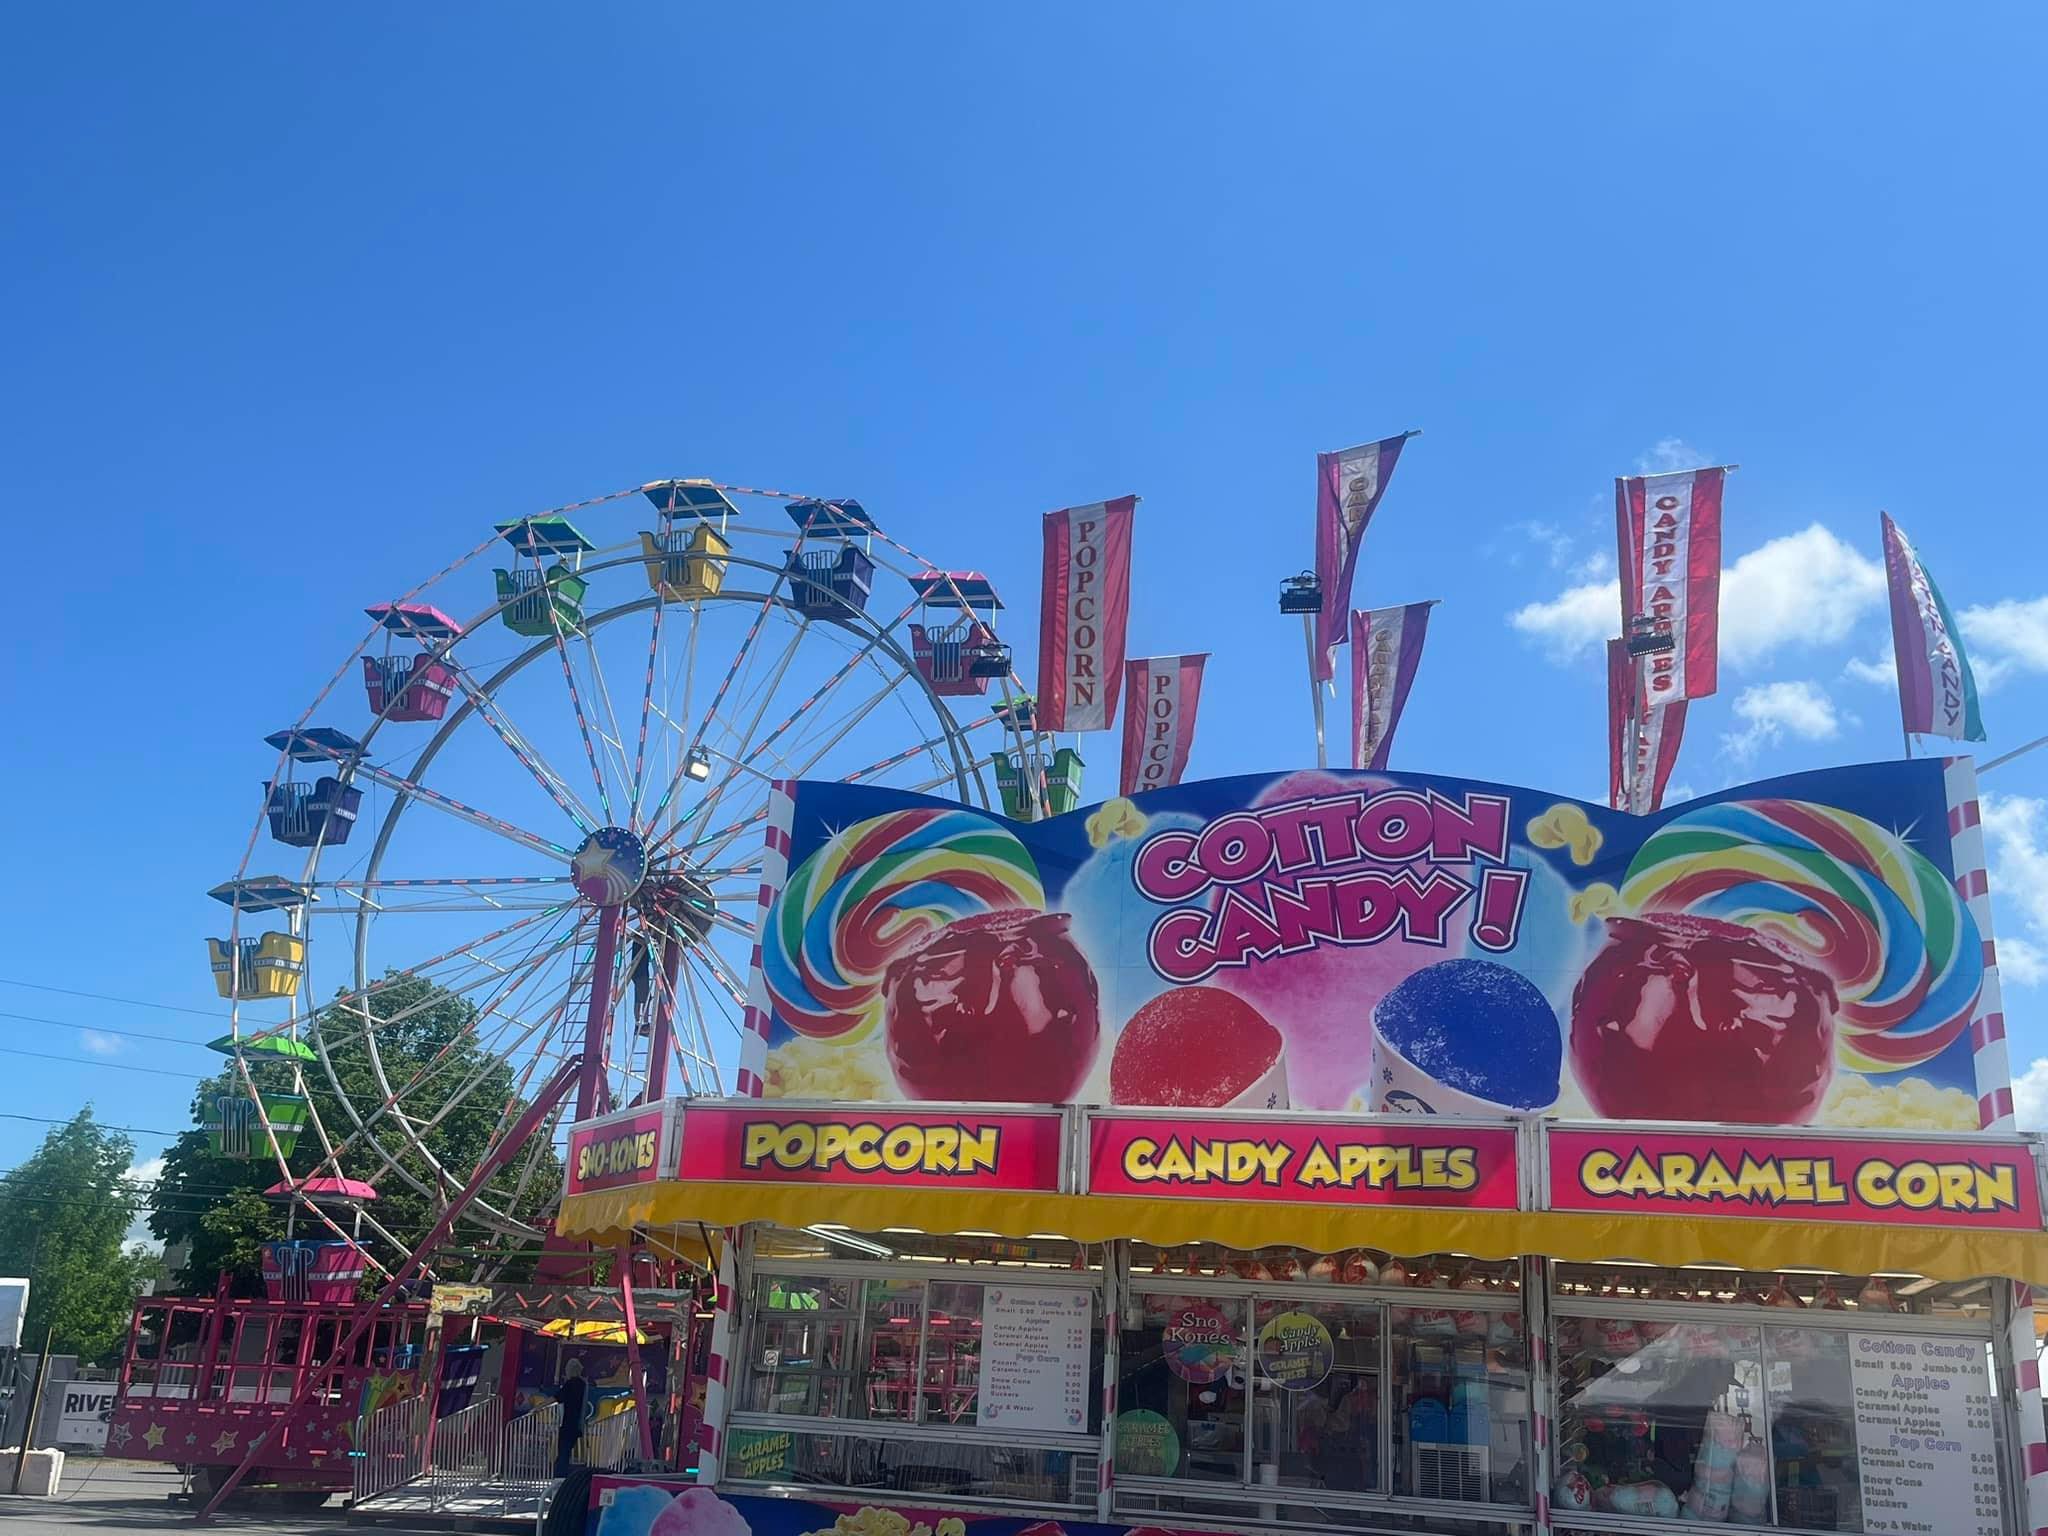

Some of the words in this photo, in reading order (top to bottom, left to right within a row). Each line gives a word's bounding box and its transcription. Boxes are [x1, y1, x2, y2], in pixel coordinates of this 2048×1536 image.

[1652, 496, 1679, 575] CANDY
[1073, 520, 1097, 707] POPCORN
[1650, 586, 1674, 692] APPES
[1132, 786, 1511, 904] COTTON
[577, 1129, 656, 1181] SNO-KONES
[742, 1121, 1001, 1175] POPCORN
[1121, 1134, 1295, 1185] CANDY
[1295, 1135, 1480, 1192] APPLES
[1578, 1146, 1848, 1209] CARAMEL
[1853, 1157, 2019, 1212] CORN
[1182, 1312, 1221, 1329] Sno
[1171, 1327, 1231, 1345] Kones
[1279, 1324, 1320, 1340] Candy
[1279, 1336, 1321, 1353] Apples
[1859, 1338, 1916, 1356] Cotton
[1921, 1342, 1976, 1361] Candy
[1855, 1359, 1884, 1369] Small
[1922, 1363, 1958, 1374] Jumbo
[1891, 1374, 1950, 1391] Apples
[1855, 1387, 1888, 1399] Candy
[1892, 1390, 1928, 1401] Apples
[1857, 1401, 1901, 1412] Caramel
[1904, 1403, 1940, 1415] Apples
[1858, 1414, 1901, 1426] Caramel
[1904, 1417, 1941, 1428] Apples
[740, 1432, 791, 1460] CARAMEL
[1889, 1435, 1920, 1451] Pop
[1924, 1437, 1962, 1453] Corn
[744, 1453, 785, 1478] APPLES
[1862, 1457, 1904, 1468] Caramel
[1908, 1460, 1934, 1470] Corn
[1863, 1474, 1892, 1485] Snow
[1895, 1476, 1923, 1487] Cone
[1864, 1486, 1894, 1497] Slush
[1864, 1497, 1908, 1509] Suckers
[1866, 1518, 1887, 1530] Pop
[1890, 1520, 1898, 1529] &
[1902, 1521, 1933, 1532] Water
